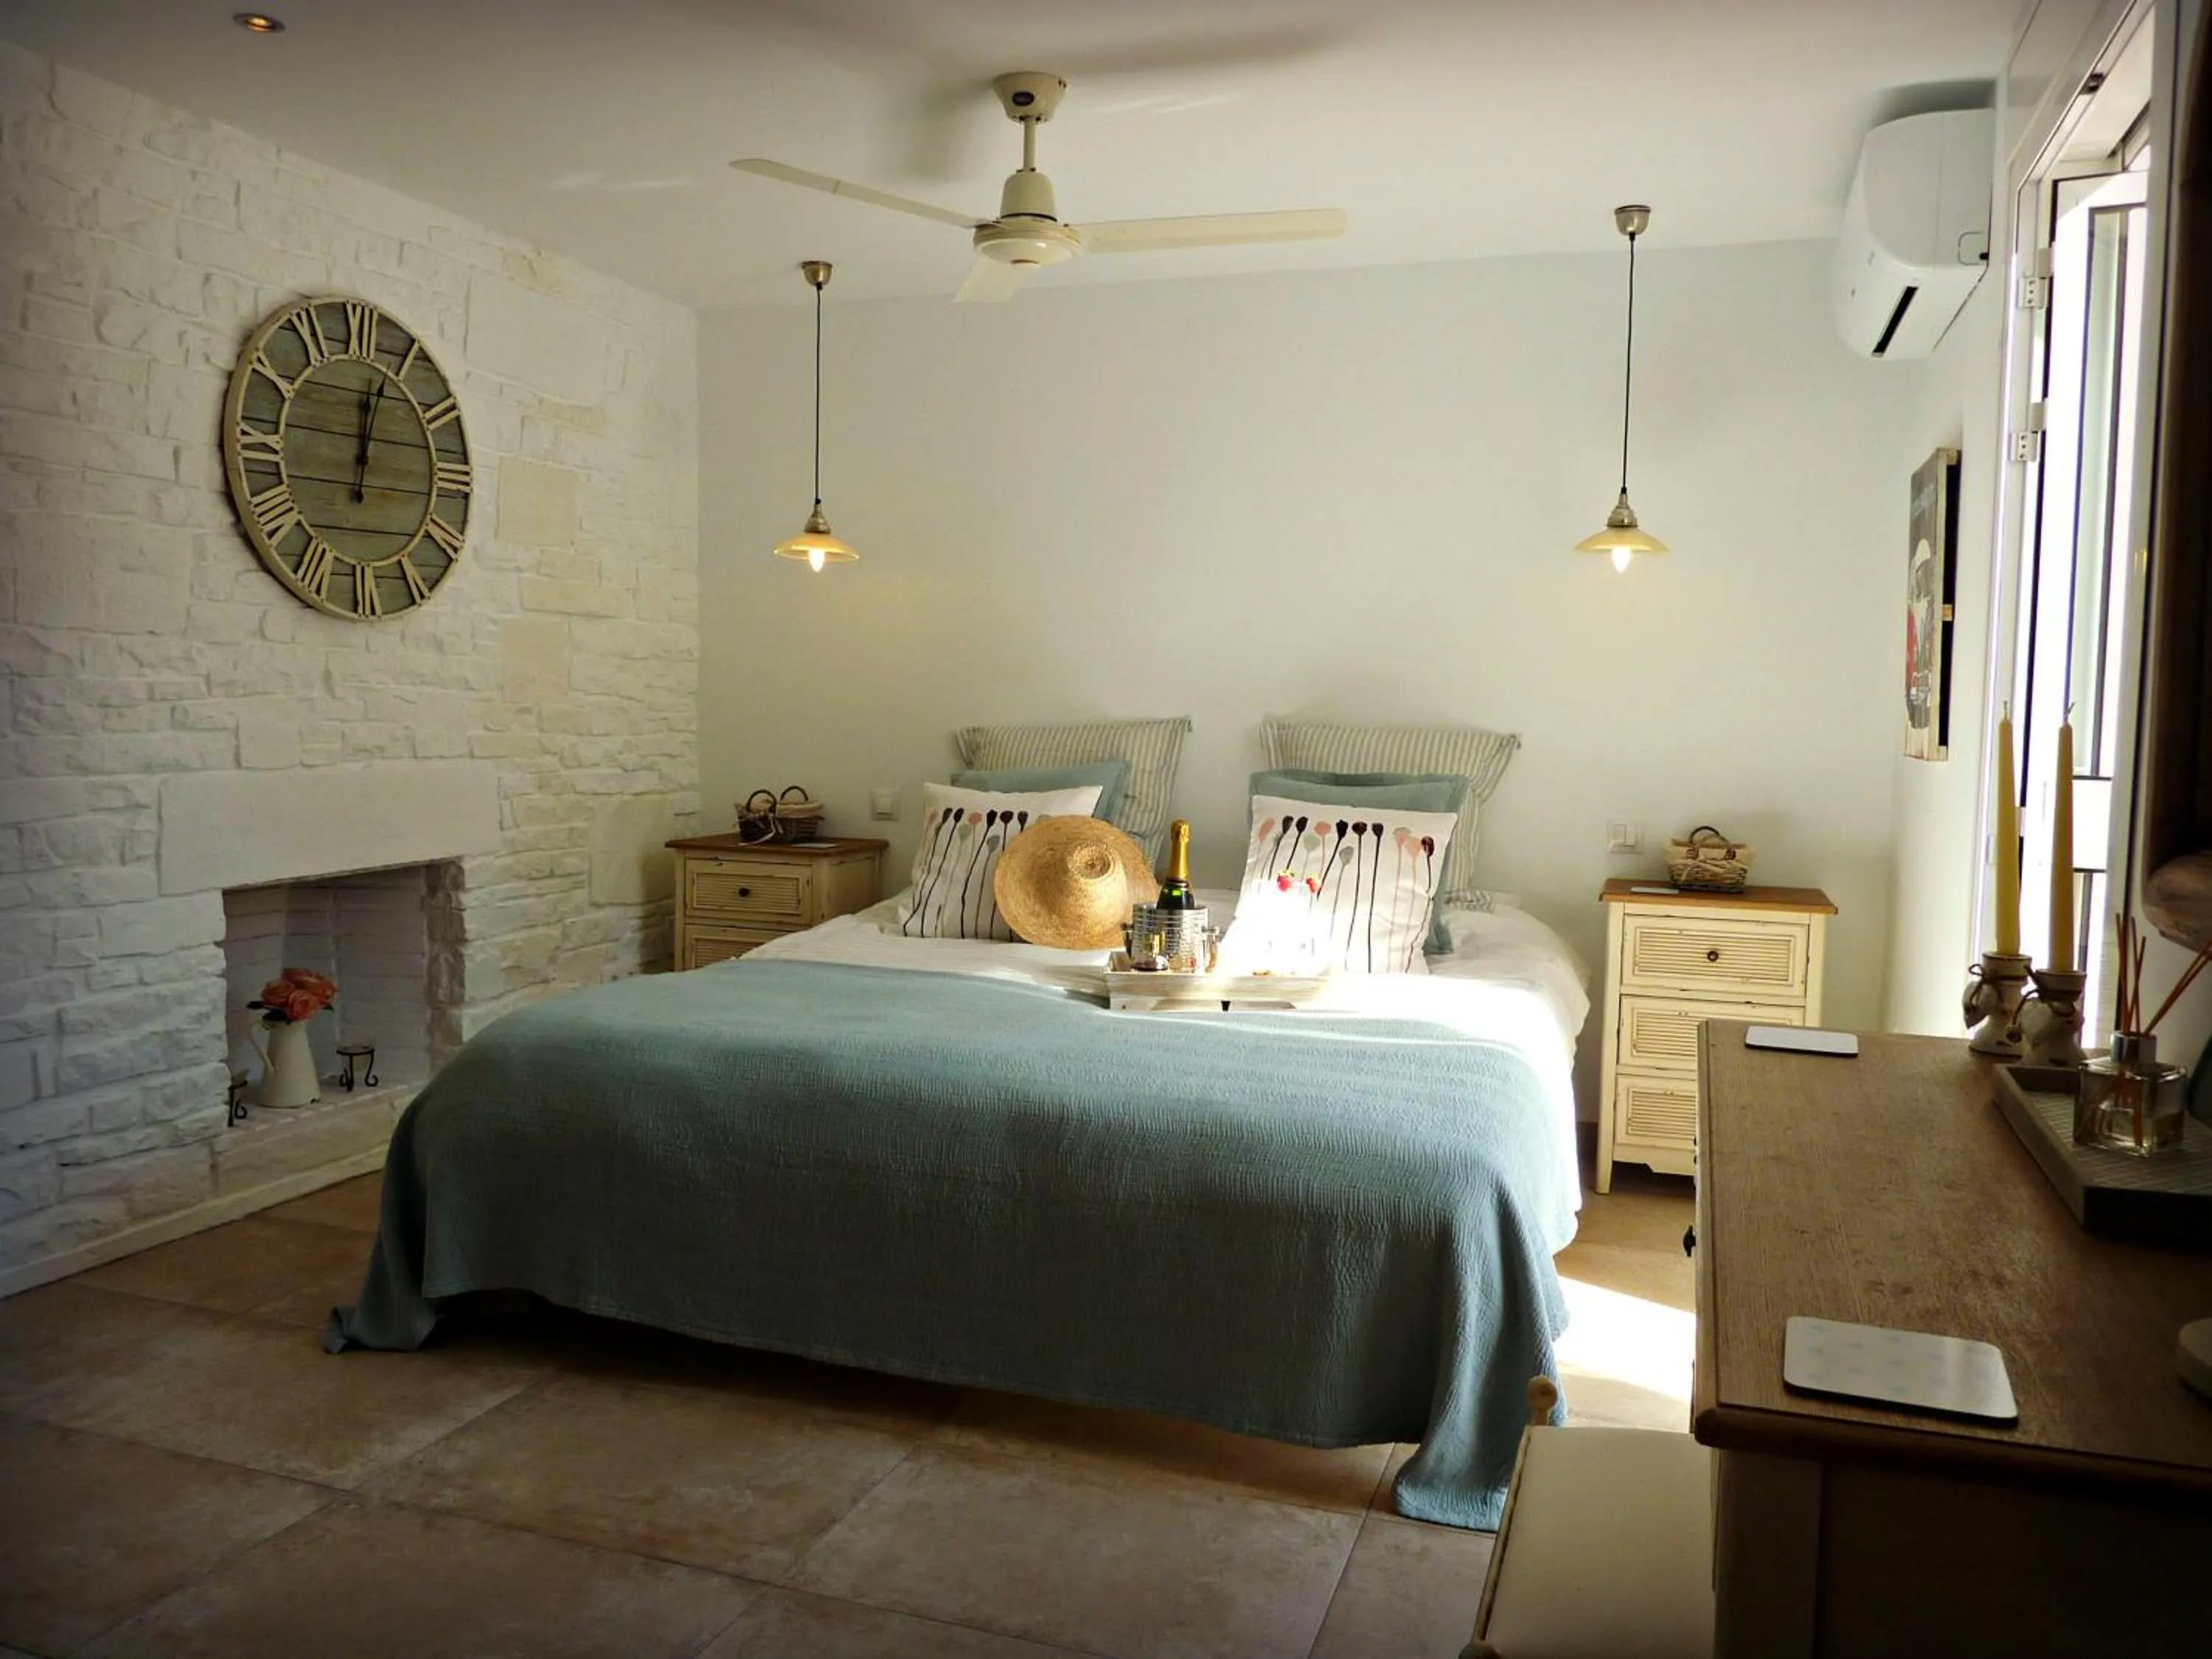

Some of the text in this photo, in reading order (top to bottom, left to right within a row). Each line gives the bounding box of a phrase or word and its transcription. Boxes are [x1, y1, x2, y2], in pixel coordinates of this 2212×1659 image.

[344, 300, 379, 362] XII
[422, 393, 461, 430] II
[434, 461, 473, 493] III
[355, 563, 383, 618] VI
[400, 553, 431, 608] V
